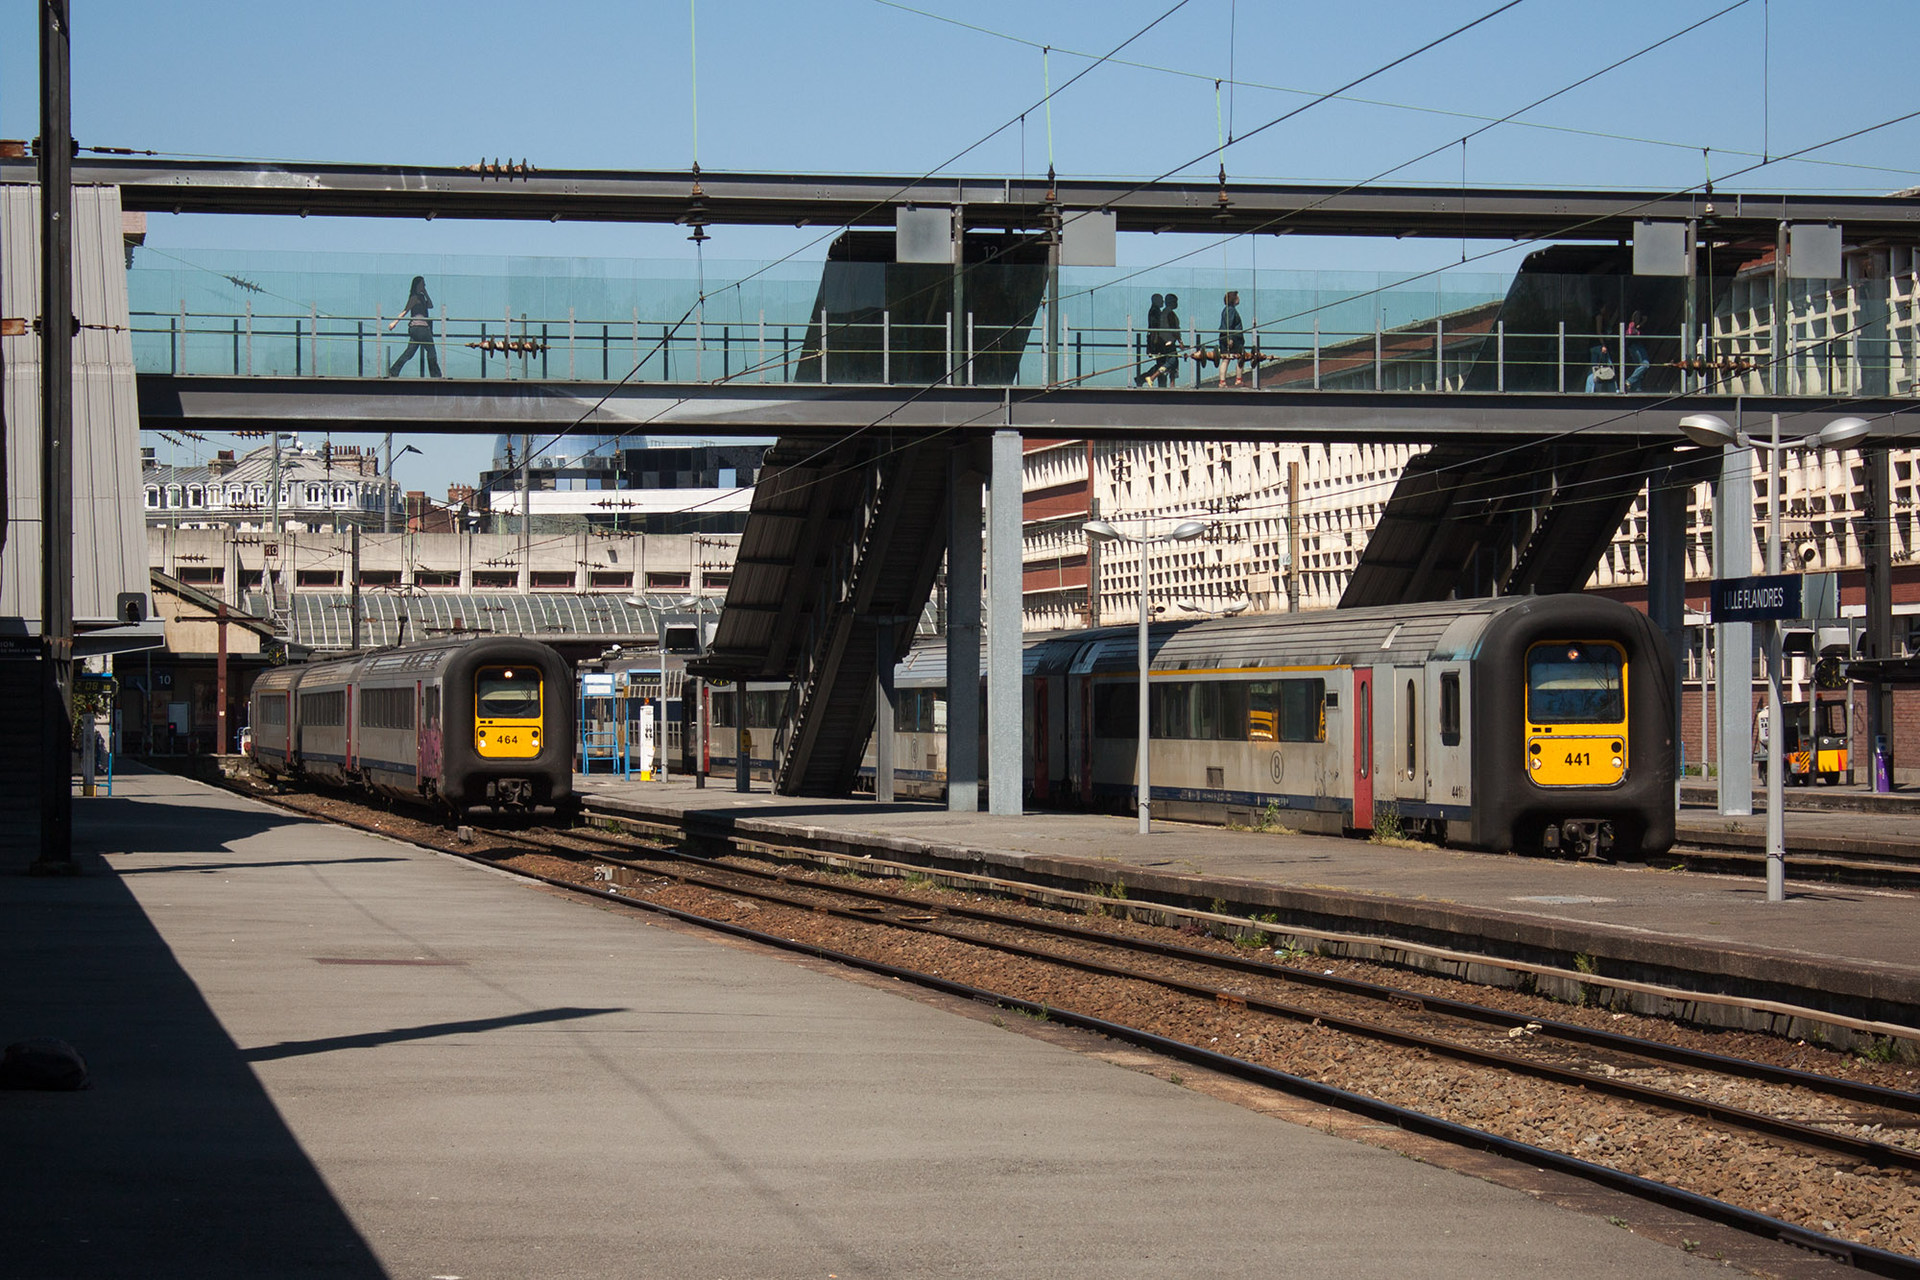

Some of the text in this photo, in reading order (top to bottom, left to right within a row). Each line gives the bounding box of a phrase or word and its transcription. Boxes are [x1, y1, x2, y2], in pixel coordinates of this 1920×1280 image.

[983, 245, 999, 258] 12
[266, 546, 278, 555] 10
[1743, 587, 1784, 609] FLANDRES
[159, 675, 171, 685] 10
[497, 735, 518, 744] 464
[1565, 752, 1591, 766] 441
